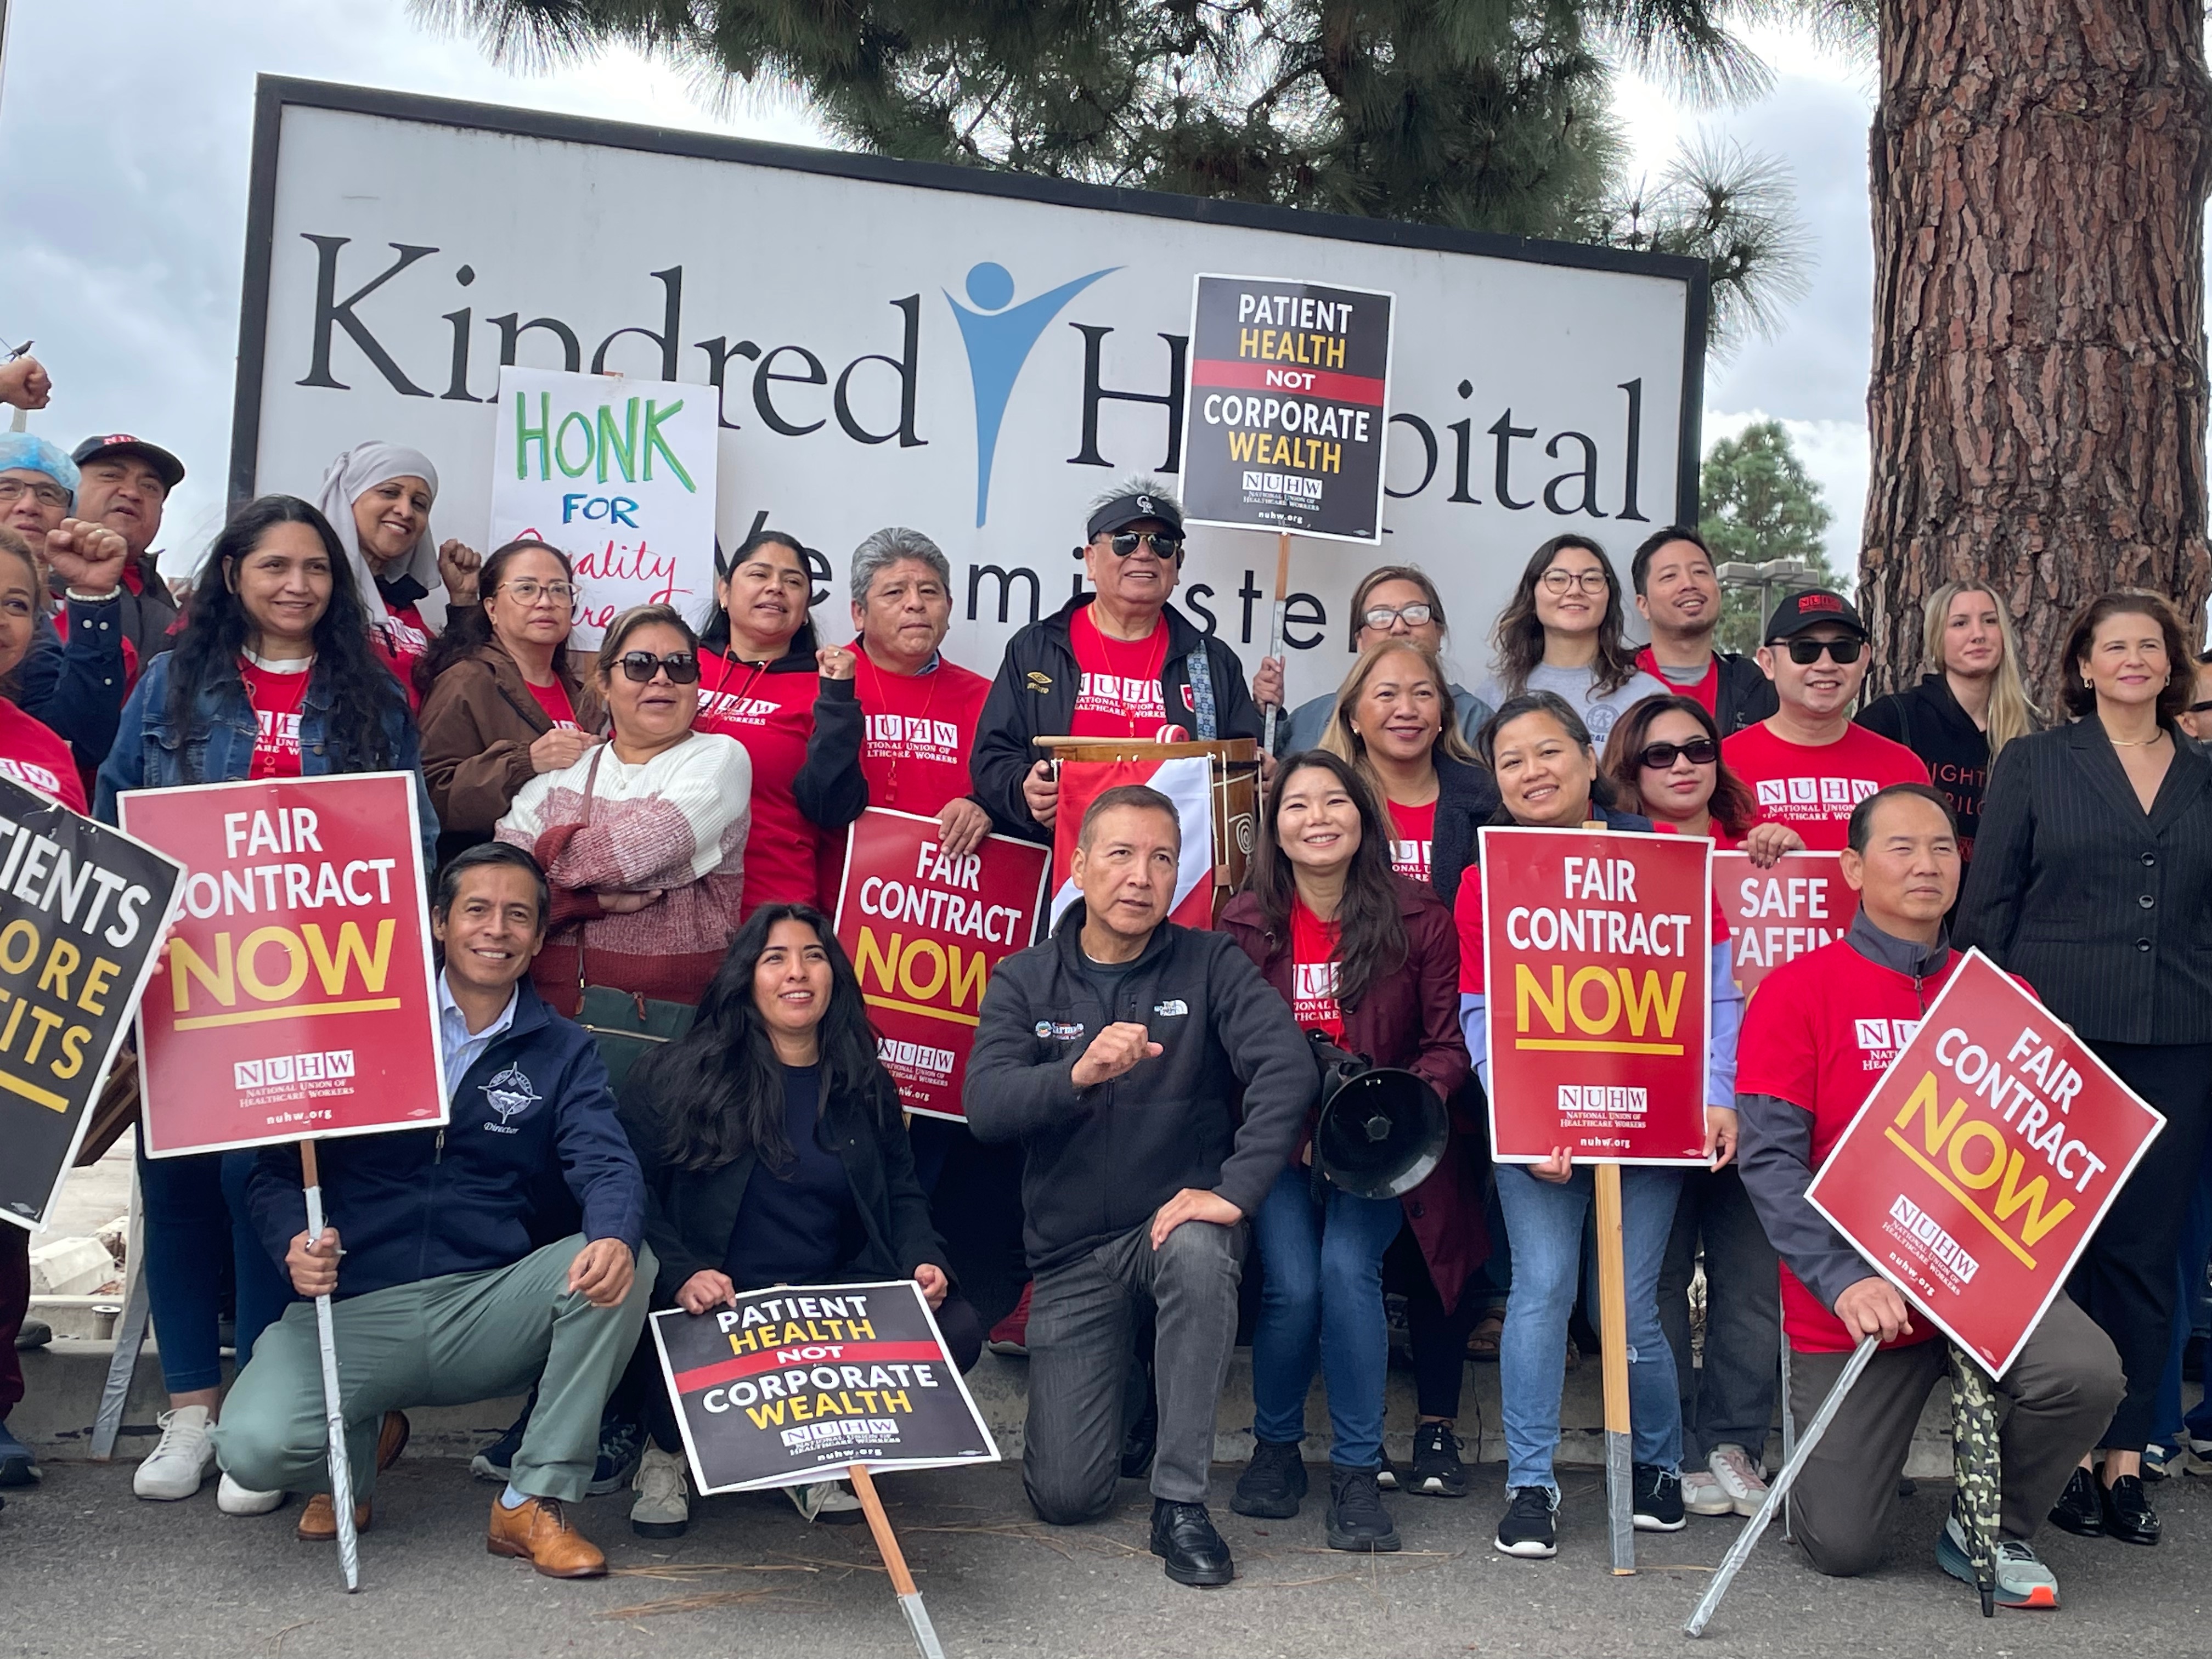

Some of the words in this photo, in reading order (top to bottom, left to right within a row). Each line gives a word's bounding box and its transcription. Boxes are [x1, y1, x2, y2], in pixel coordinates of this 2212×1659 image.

[1238, 294, 1353, 334] PATIENT
[1239, 328, 1346, 369] HEALTH
[295, 233, 928, 447] Kindred
[1067, 323, 1650, 534] Hpital
[1266, 369, 1316, 390] NOT
[1204, 394, 1370, 442] CORPORATE
[516, 391, 696, 493] HONK
[1228, 431, 1342, 474] WEALTH
[1244, 472, 1322, 497] NUHW
[1249, 490, 1283, 499] NATIONAL
[562, 493, 639, 528] FOR
[1259, 511, 1303, 524] nuhw.org
[514, 528, 694, 604] ality
[572, 605, 615, 629] re
[865, 715, 957, 747] UHW
[867, 741, 902, 749] TIONAL
[906, 742, 936, 752] UNION
[867, 749, 911, 758] LTHCARE
[915, 751, 957, 765] WORKERS
[1769, 804, 1820, 813] NATIONAL
[1822, 804, 1856, 812] UNION
[224, 808, 323, 859] FAIR
[916, 840, 981, 892] FAIR
[1564, 856, 1637, 903] FAIR
[175, 859, 396, 922] ONTRACT
[1740, 877, 1829, 919] SAFE
[860, 876, 1022, 946] CONTRACT
[1506, 906, 1691, 957] CONTRACT
[0, 918, 122, 1016] ORE
[169, 918, 396, 1012] NOW
[1515, 963, 1687, 1039] NOW
[0, 989, 92, 1079] ITS
[236, 1052, 353, 1088] NUHW
[877, 1039, 954, 1071] NUHW
[2007, 1027, 2083, 1115] FAIR
[239, 1092, 306, 1108] HEALTHCARE
[308, 1087, 355, 1098] WORKERS
[247, 1085, 296, 1098] NATIONAL
[300, 1081, 332, 1091] UNION
[334, 1079, 346, 1087] OF
[898, 1086, 930, 1102] hw.org
[1560, 1087, 1646, 1110] NUHW
[267, 1109, 332, 1125] nuhw.org
[1560, 1119, 1613, 1127] HEALTHCARE
[1615, 1120, 1646, 1128] WORKERS
[1566, 1111, 1607, 1120] NATIONAL
[1936, 1027, 2107, 1193] CONTRACT
[1580, 1136, 1630, 1149] nuhw.org
[1893, 1070, 2076, 1247] NOW
[1891, 1220, 1928, 1255] NATIONAL
[1928, 1251, 1951, 1277] UNION
[1950, 1273, 1960, 1284] OF
[1892, 1196, 1978, 1280] NUHW
[1882, 1221, 1929, 1266] HEALTHCARE
[1929, 1262, 1961, 1296] WORKERS
[1889, 1251, 1936, 1297] nuhw.org
[716, 1296, 868, 1334] PATIENT
[729, 1318, 877, 1355] HEALTH
[776, 1345, 844, 1364] NOT
[703, 1364, 939, 1414] CORPORATE
[746, 1390, 913, 1430] WEALTH
[785, 1420, 895, 1444] NUHW
[817, 1448, 882, 1462] nuhw.org
